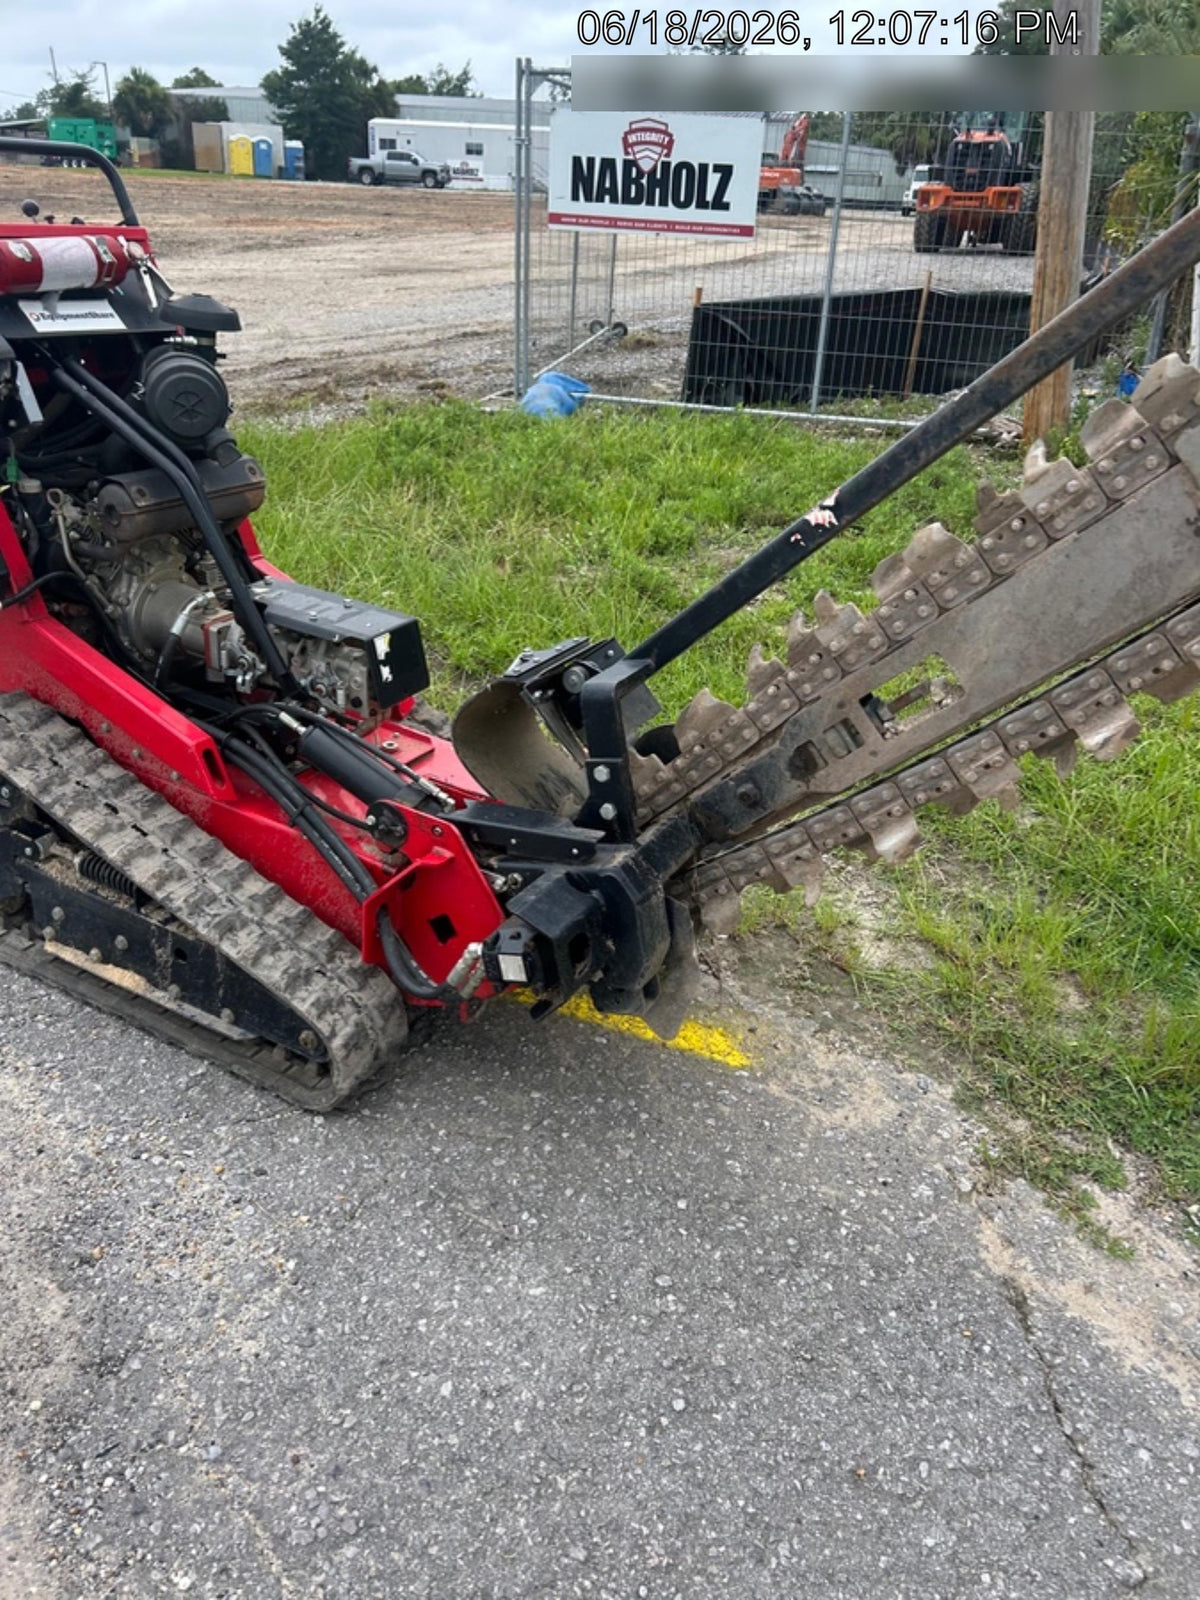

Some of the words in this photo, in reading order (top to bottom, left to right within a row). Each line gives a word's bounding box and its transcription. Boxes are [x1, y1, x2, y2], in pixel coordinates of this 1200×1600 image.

[627, 131, 670, 145] INTEGRITY
[571, 155, 734, 212] NABHOLZ
[40, 311, 115, 322] EquipmentShare
